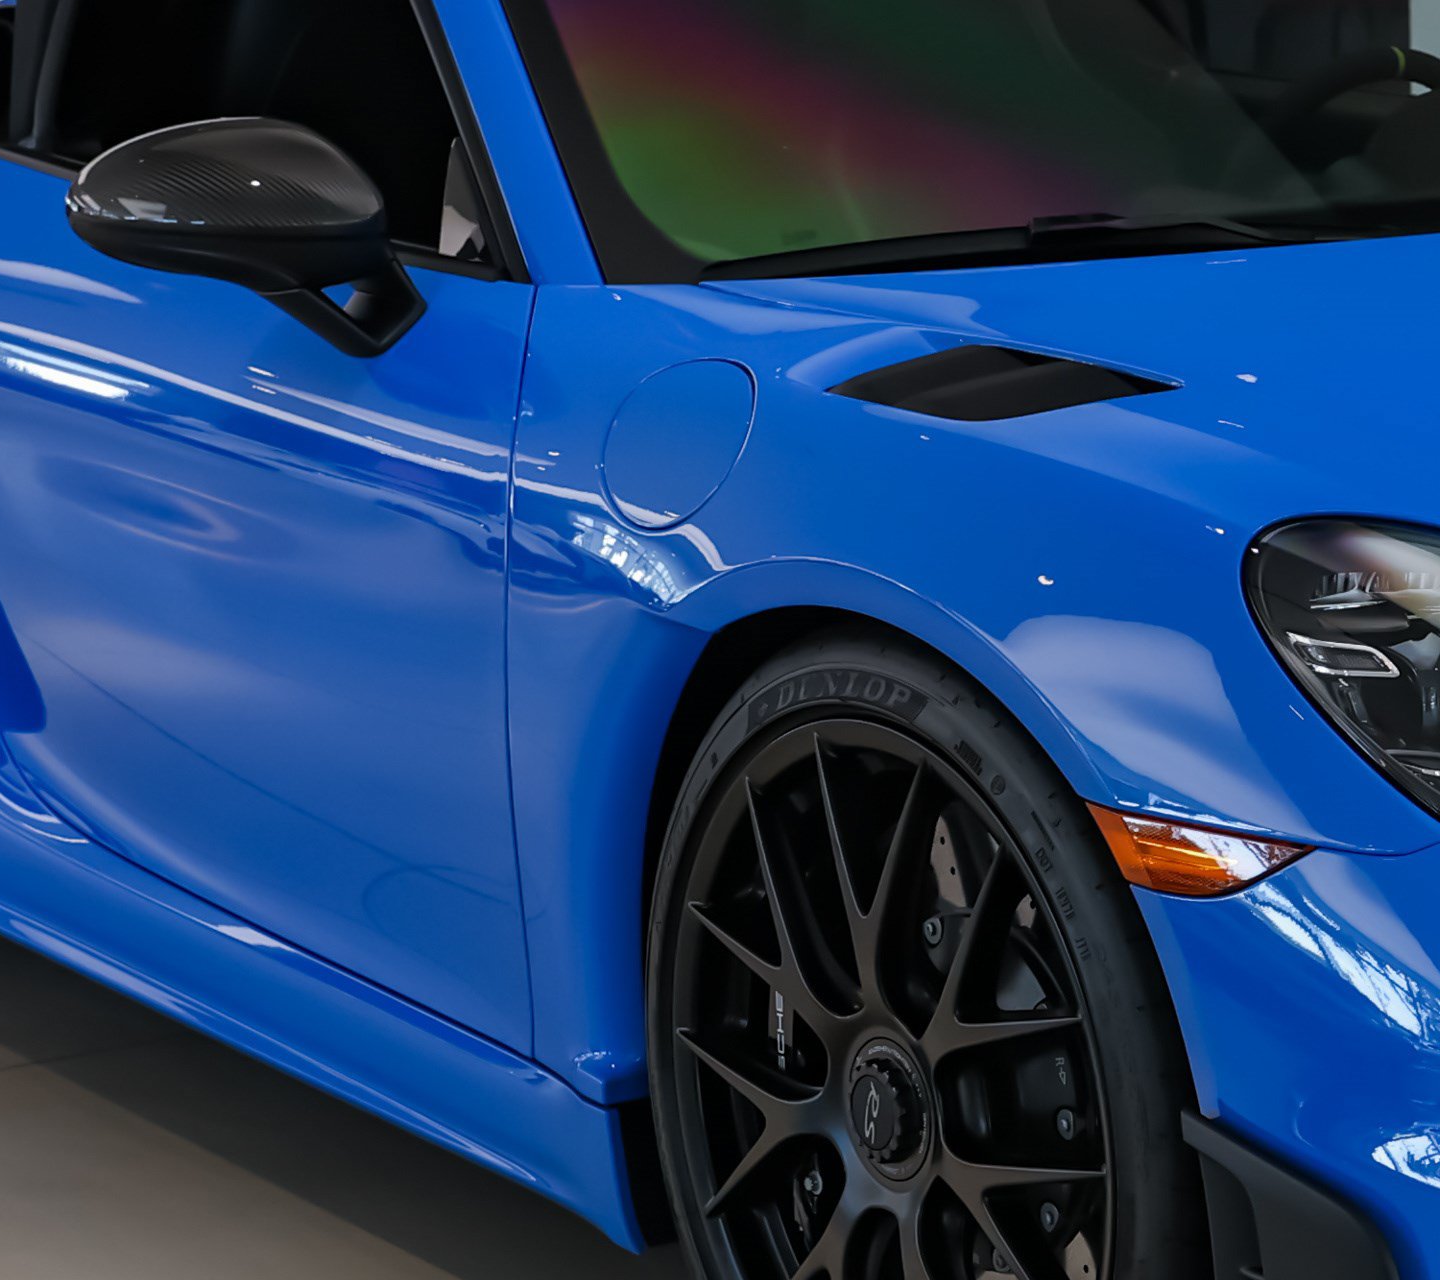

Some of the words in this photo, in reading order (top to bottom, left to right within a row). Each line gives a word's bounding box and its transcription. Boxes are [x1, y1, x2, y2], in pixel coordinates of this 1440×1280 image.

[776, 671, 912, 711] DUNLOP
[774, 990, 786, 1071] SCHE
[864, 1081, 880, 1145] RS
